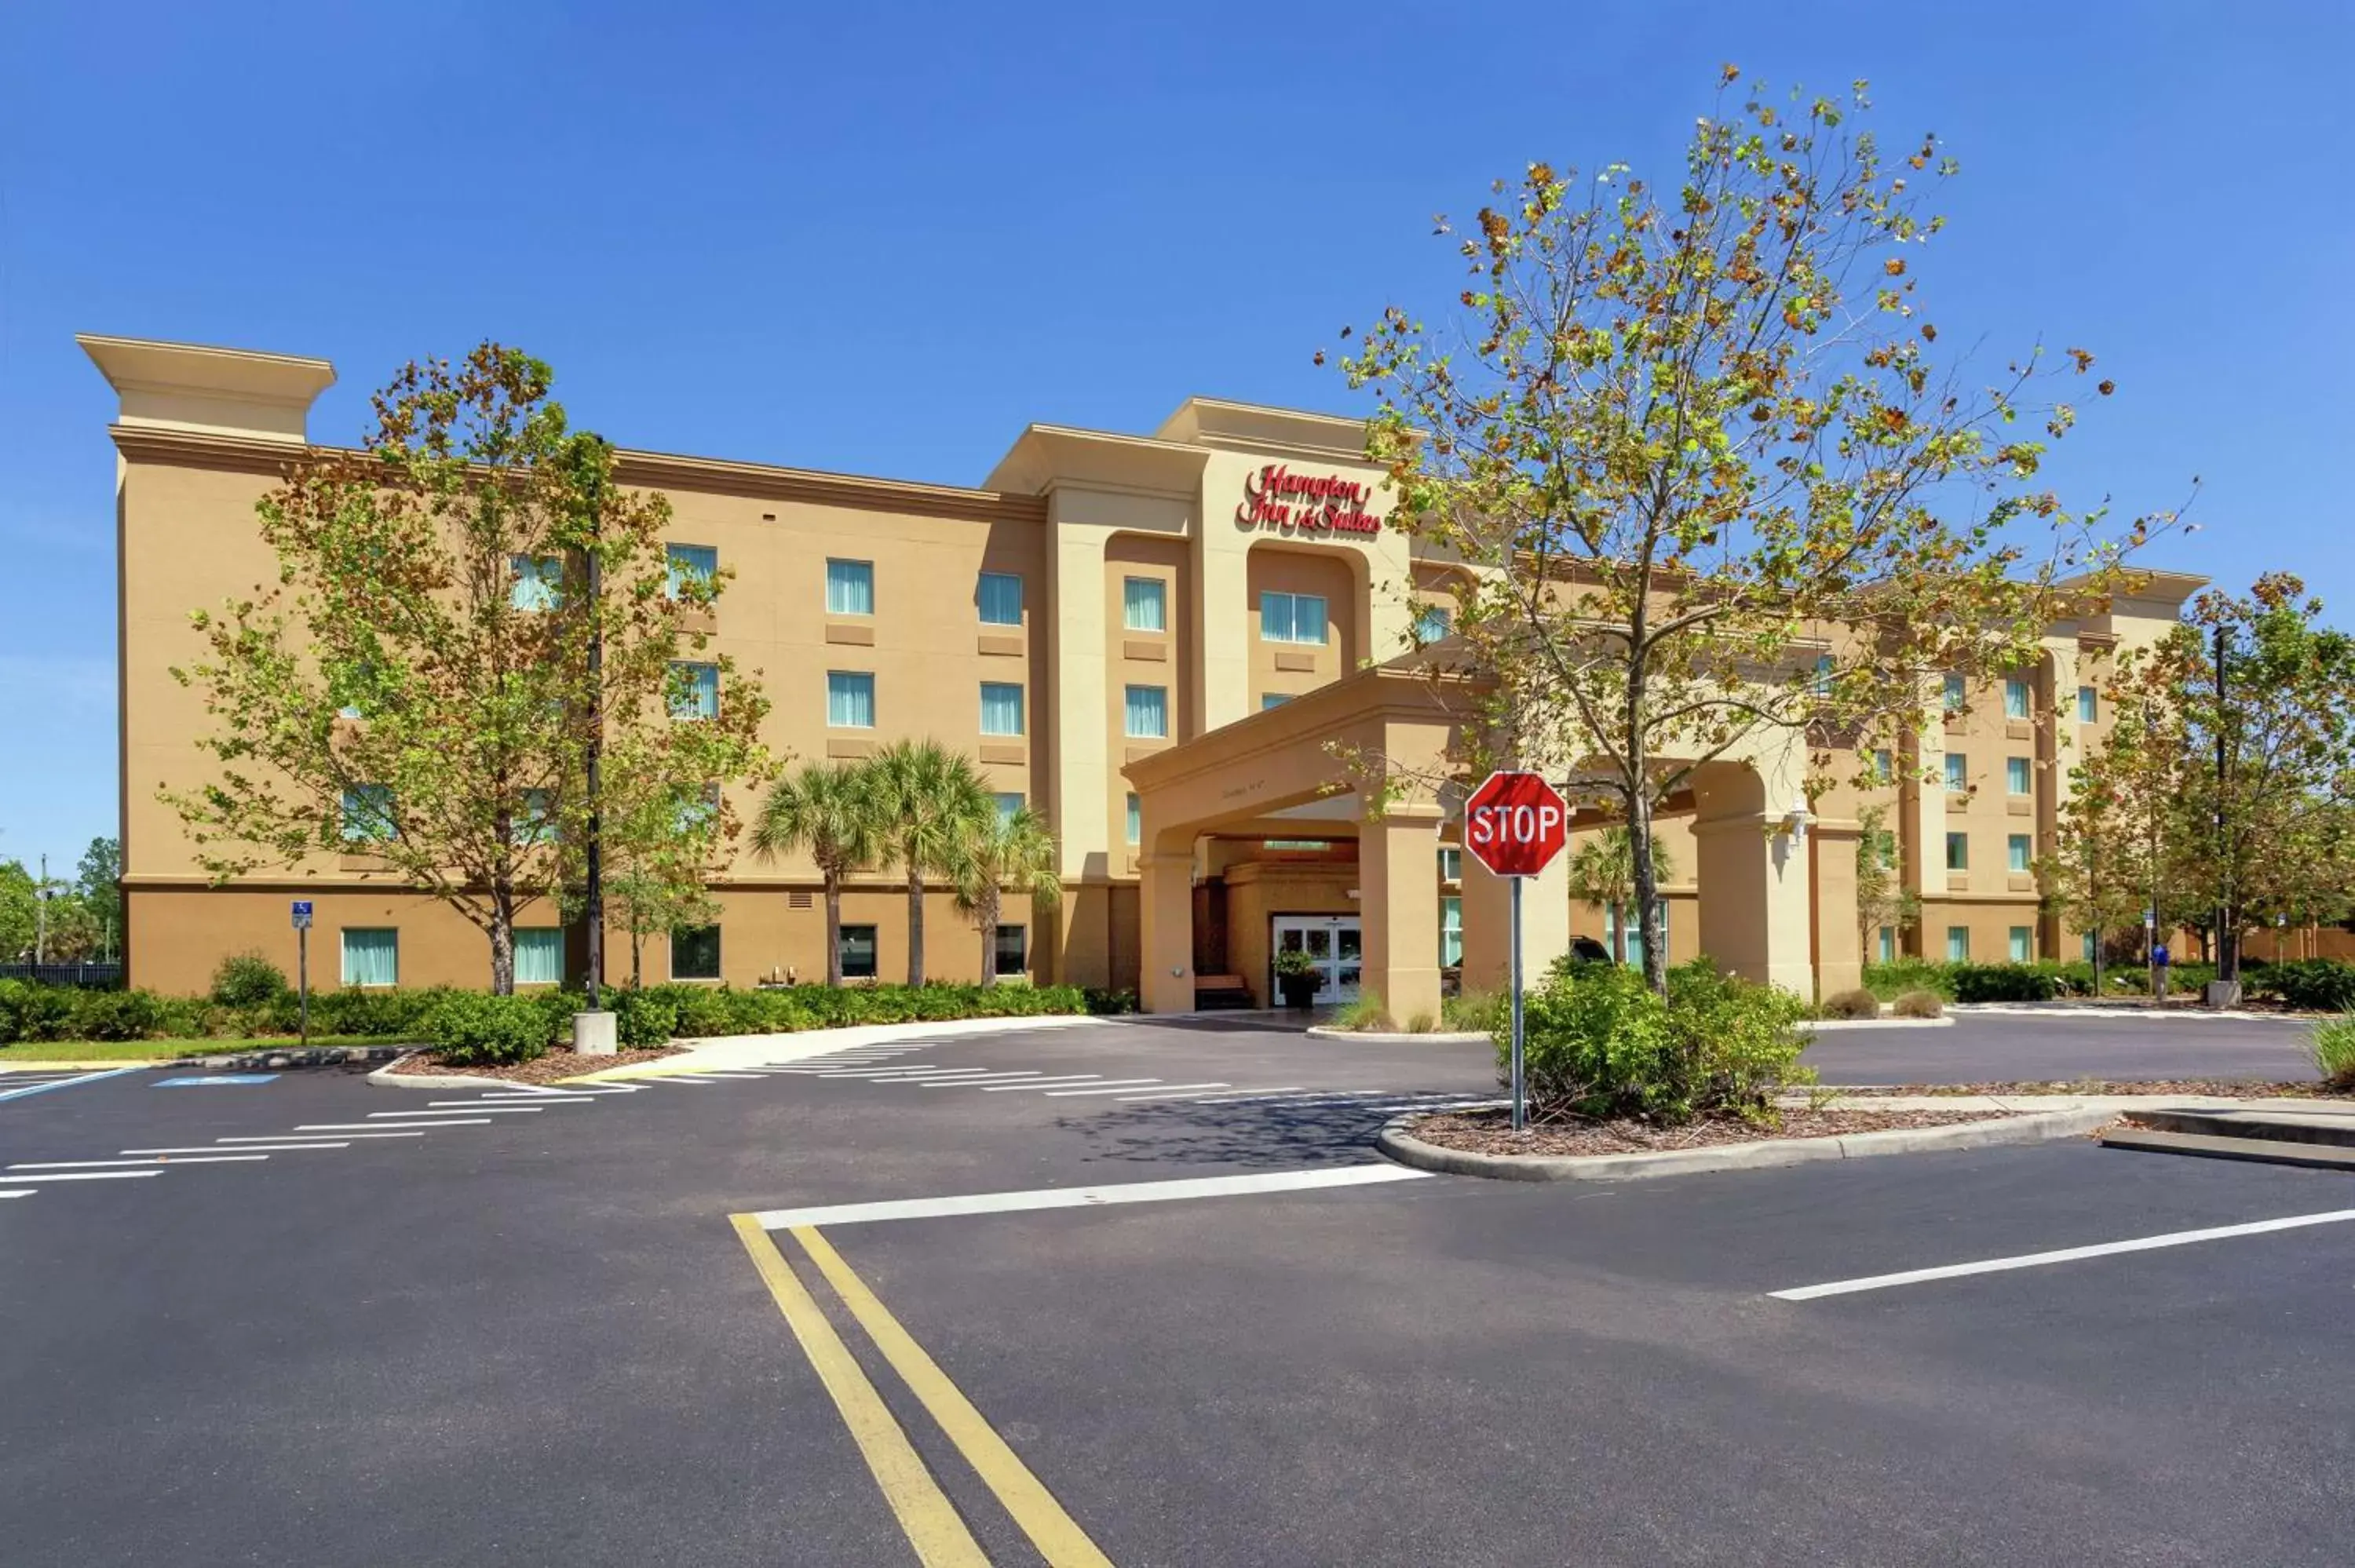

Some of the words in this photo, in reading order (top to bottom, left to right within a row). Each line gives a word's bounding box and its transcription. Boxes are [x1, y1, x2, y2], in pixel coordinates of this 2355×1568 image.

[1247, 465, 1371, 505] Hampton
[1236, 496, 1300, 528] Inn
[1300, 508, 1316, 530] &
[1317, 505, 1382, 534] Suites
[1473, 804, 1560, 844] STOP
